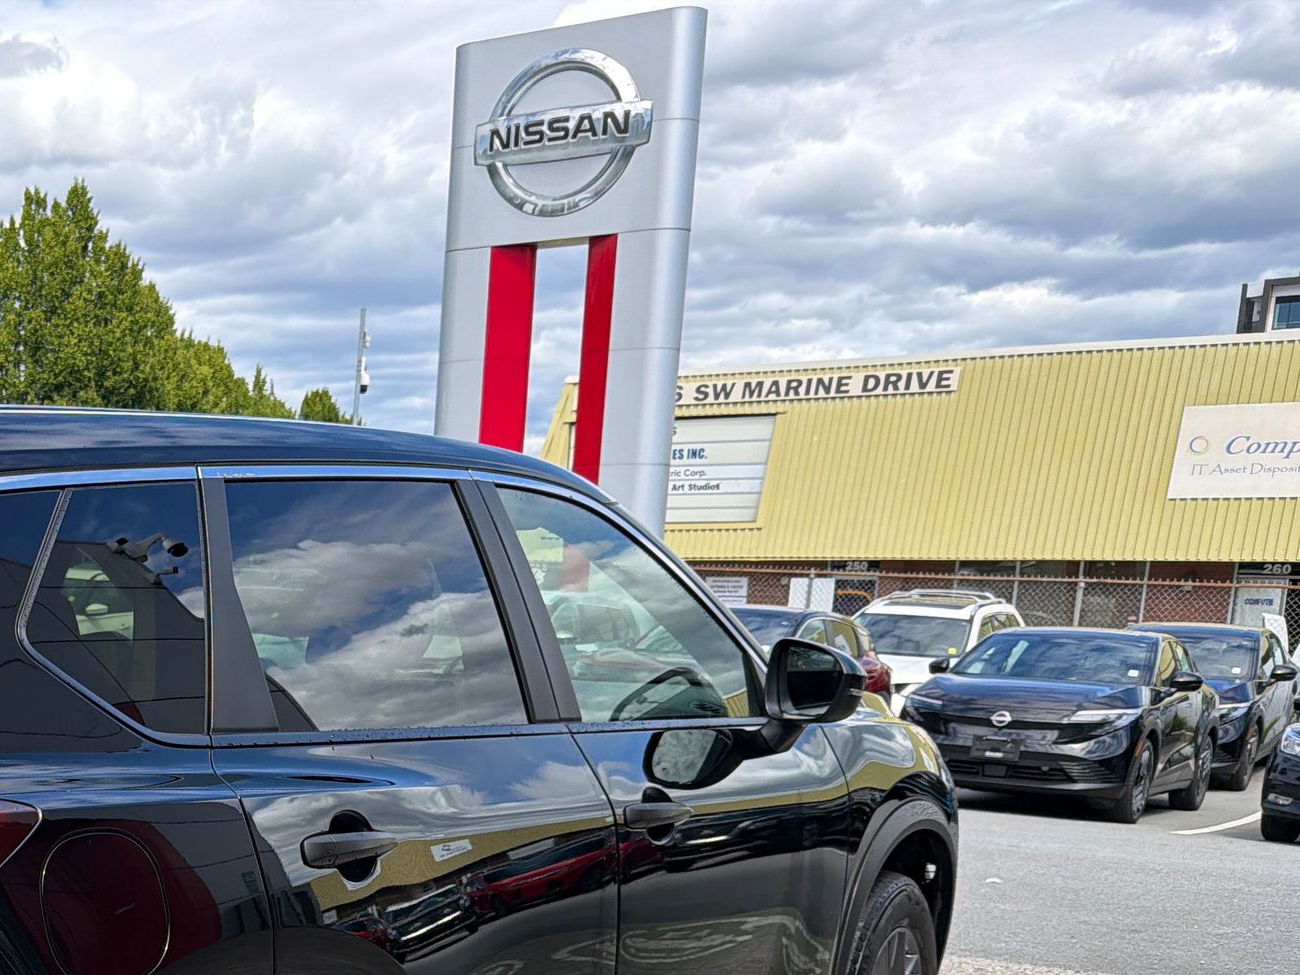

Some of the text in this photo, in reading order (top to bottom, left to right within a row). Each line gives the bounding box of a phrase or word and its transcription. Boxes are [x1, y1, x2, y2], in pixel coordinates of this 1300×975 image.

[489, 109, 631, 153] NISSAN
[692, 382, 736, 402] SW
[741, 375, 852, 400] MARINE
[861, 369, 954, 393] DRIVE
[1225, 435, 1300, 459] Comp
[687, 447, 708, 460] INC.
[683, 468, 707, 478] Corp.
[1209, 463, 1247, 475] Asset
[671, 482, 720, 491] Art Studios
[845, 561, 869, 571] 250
[1262, 563, 1292, 575] 260
